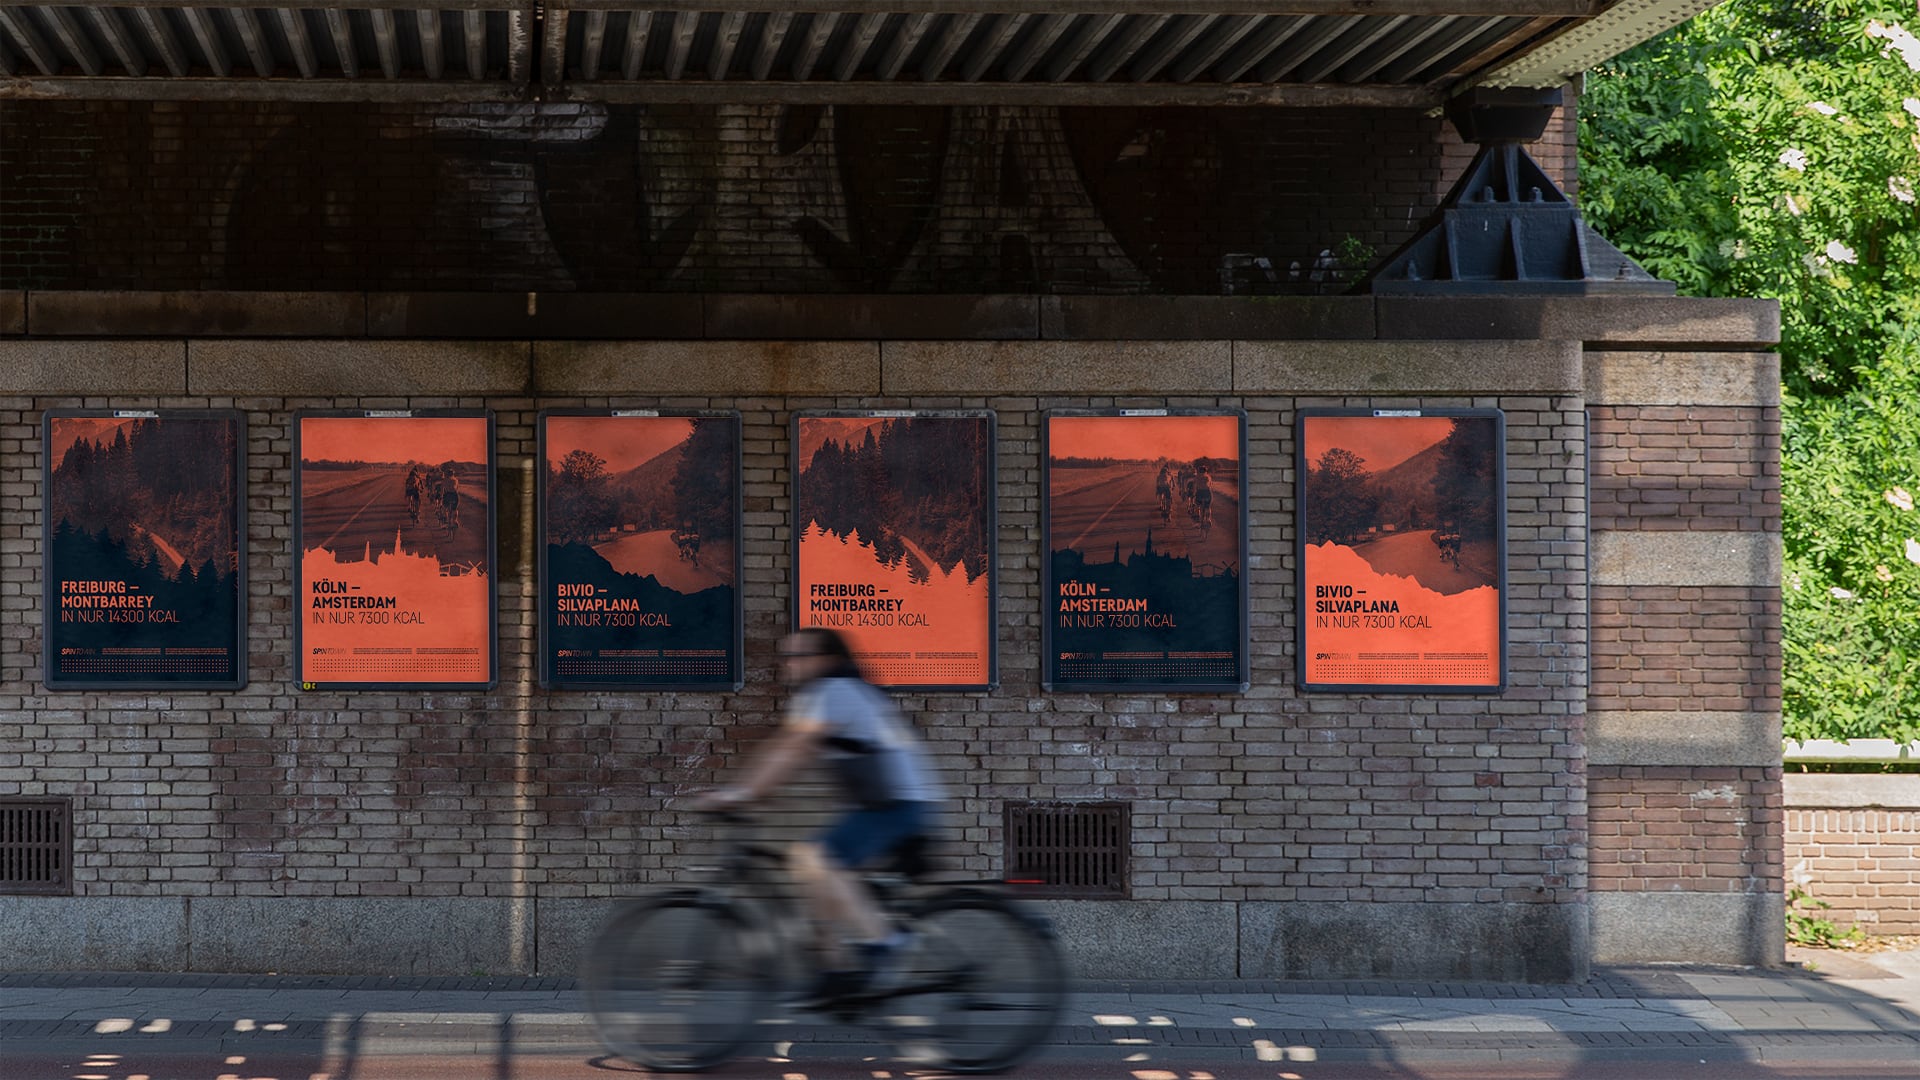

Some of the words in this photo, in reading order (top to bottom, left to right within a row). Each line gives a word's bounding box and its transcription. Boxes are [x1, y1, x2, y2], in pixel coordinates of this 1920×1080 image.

[62, 581, 125, 593] FREIBURG
[313, 578, 347, 594] KÖLN
[558, 584, 594, 596] BIVIO
[811, 584, 875, 597] FREIBURG
[1060, 580, 1096, 596] KÖLN
[1316, 585, 1352, 598] BIVIO
[62, 596, 154, 608] MONTBARREY
[312, 596, 396, 609] AMSTERDAM
[558, 599, 640, 611] SILVAPLANA
[811, 599, 903, 611] MONTBARREY
[1060, 599, 1147, 612] AMSTERDAM
[1316, 600, 1399, 613] SILVAPLANA
[62, 610, 73, 622] IN
[78, 610, 104, 623] NUR
[108, 610, 144, 623] 14300
[148, 610, 179, 623] KCAL
[313, 612, 324, 624] IN
[329, 611, 355, 624] NUR
[359, 611, 389, 624] 7300
[394, 611, 424, 624] KCAL
[558, 614, 570, 626] IN
[575, 613, 601, 626] NUR
[604, 613, 635, 626] 7300
[640, 613, 671, 626] KCAL
[811, 613, 823, 626] IN
[827, 613, 853, 626] NUR
[857, 613, 893, 626] 14300
[898, 613, 929, 626] KCAL
[1060, 615, 1072, 628] IN
[1078, 614, 1104, 628] NUR
[1108, 614, 1139, 627] 7300
[1144, 614, 1176, 627] KCAL
[1317, 616, 1328, 628] IN
[1333, 615, 1359, 628] NUR
[1364, 615, 1395, 628] 7300
[1400, 615, 1432, 628] KCAL
